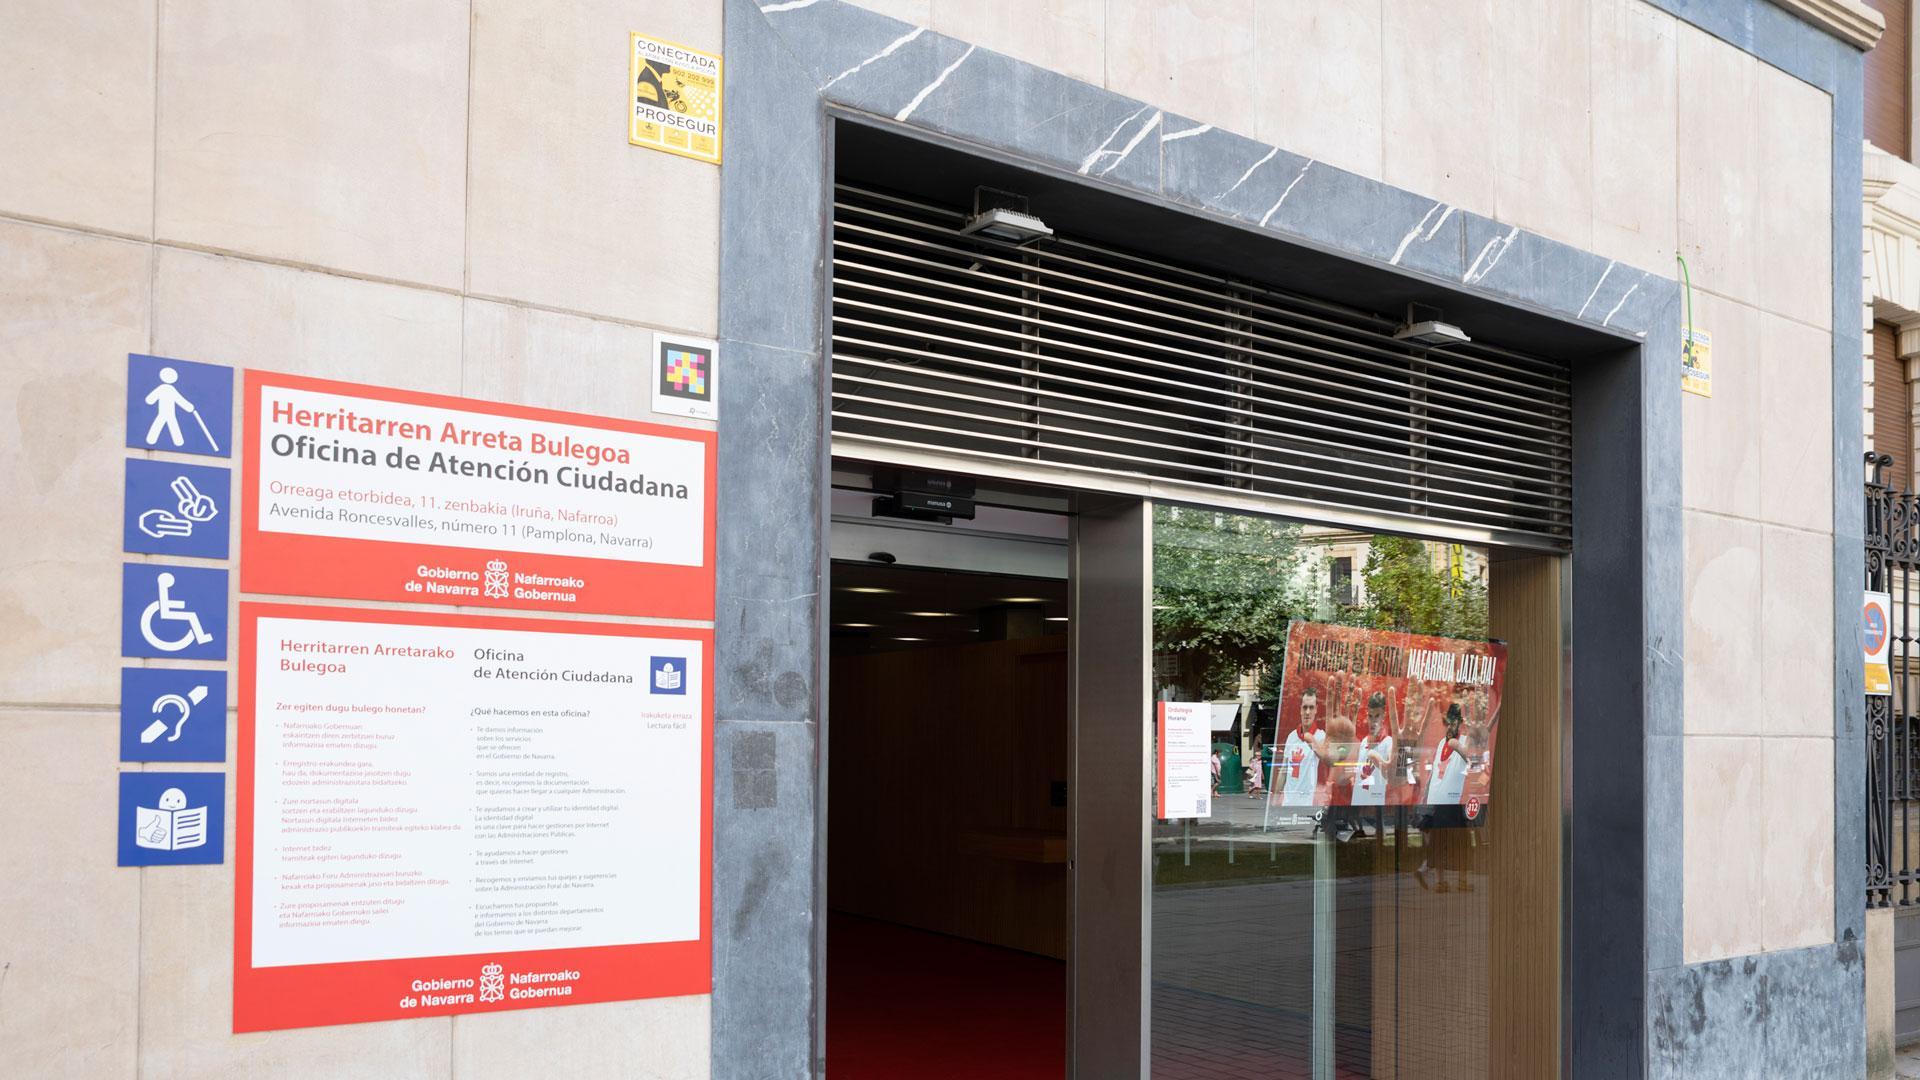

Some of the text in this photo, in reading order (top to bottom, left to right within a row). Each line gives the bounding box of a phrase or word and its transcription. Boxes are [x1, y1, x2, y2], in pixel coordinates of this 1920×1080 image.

[637, 40, 716, 69] CONECTADA
[636, 106, 716, 135] PROSEGUR
[272, 400, 630, 465] Herritarren Arreta Bulegoa
[271, 433, 688, 500] Oficina de Atención Ciudadana
[270, 481, 618, 527] Orreaga etorbidea, 11. zenbakia (Iruña, Nafarroa)
[269, 503, 653, 549] Avenida Roncesvalles, número 11 (Pamplona, Navarra)
[417, 565, 480, 581] Gobierno
[515, 573, 585, 588] Nafarroako
[405, 581, 480, 596] de Navarra
[514, 588, 577, 602] Gobernua
[280, 639, 455, 658] Herritarren Arretarako
[474, 648, 524, 662] Oficina
[280, 659, 346, 675] Bulegoa
[1407, 648, 1455, 682] NAFARROA
[1481, 656, 1497, 686] DA!
[473, 667, 633, 684] de Atención Ciudadana
[276, 702, 425, 715] Zer egiten dugu bulego honetan?
[470, 707, 492, 718] ¿Qué
[493, 707, 530, 716] hacemos
[560, 709, 590, 718] oficina?
[647, 721, 671, 729] Lectura
[510, 970, 580, 984] Nafarroako
[411, 978, 474, 992] Gobierno
[509, 986, 572, 999] Gobernua
[400, 993, 474, 1008] de Navarra
